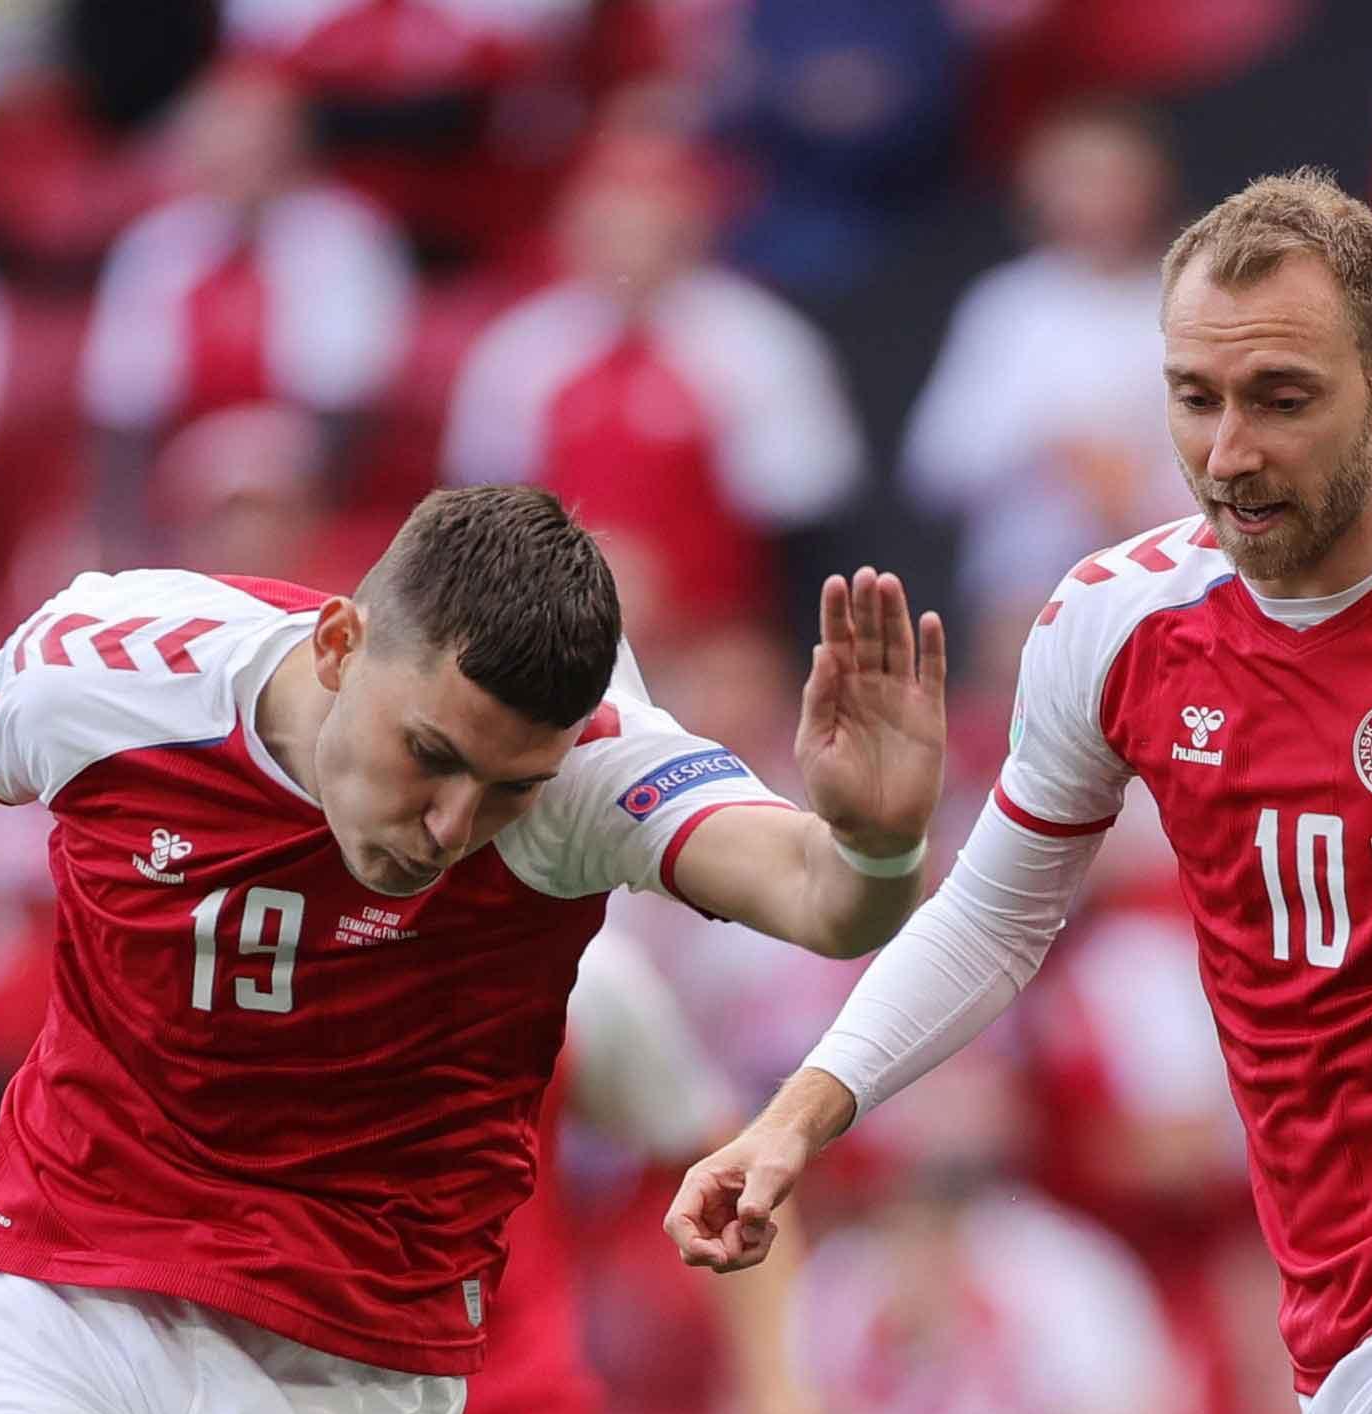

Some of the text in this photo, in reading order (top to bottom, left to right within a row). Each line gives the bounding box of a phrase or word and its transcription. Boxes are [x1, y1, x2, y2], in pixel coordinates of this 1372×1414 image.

[656, 753, 740, 792] RESPECT
[1172, 742, 1223, 767] hummel
[1254, 807, 1352, 969] 10
[191, 885, 305, 1014] 19
